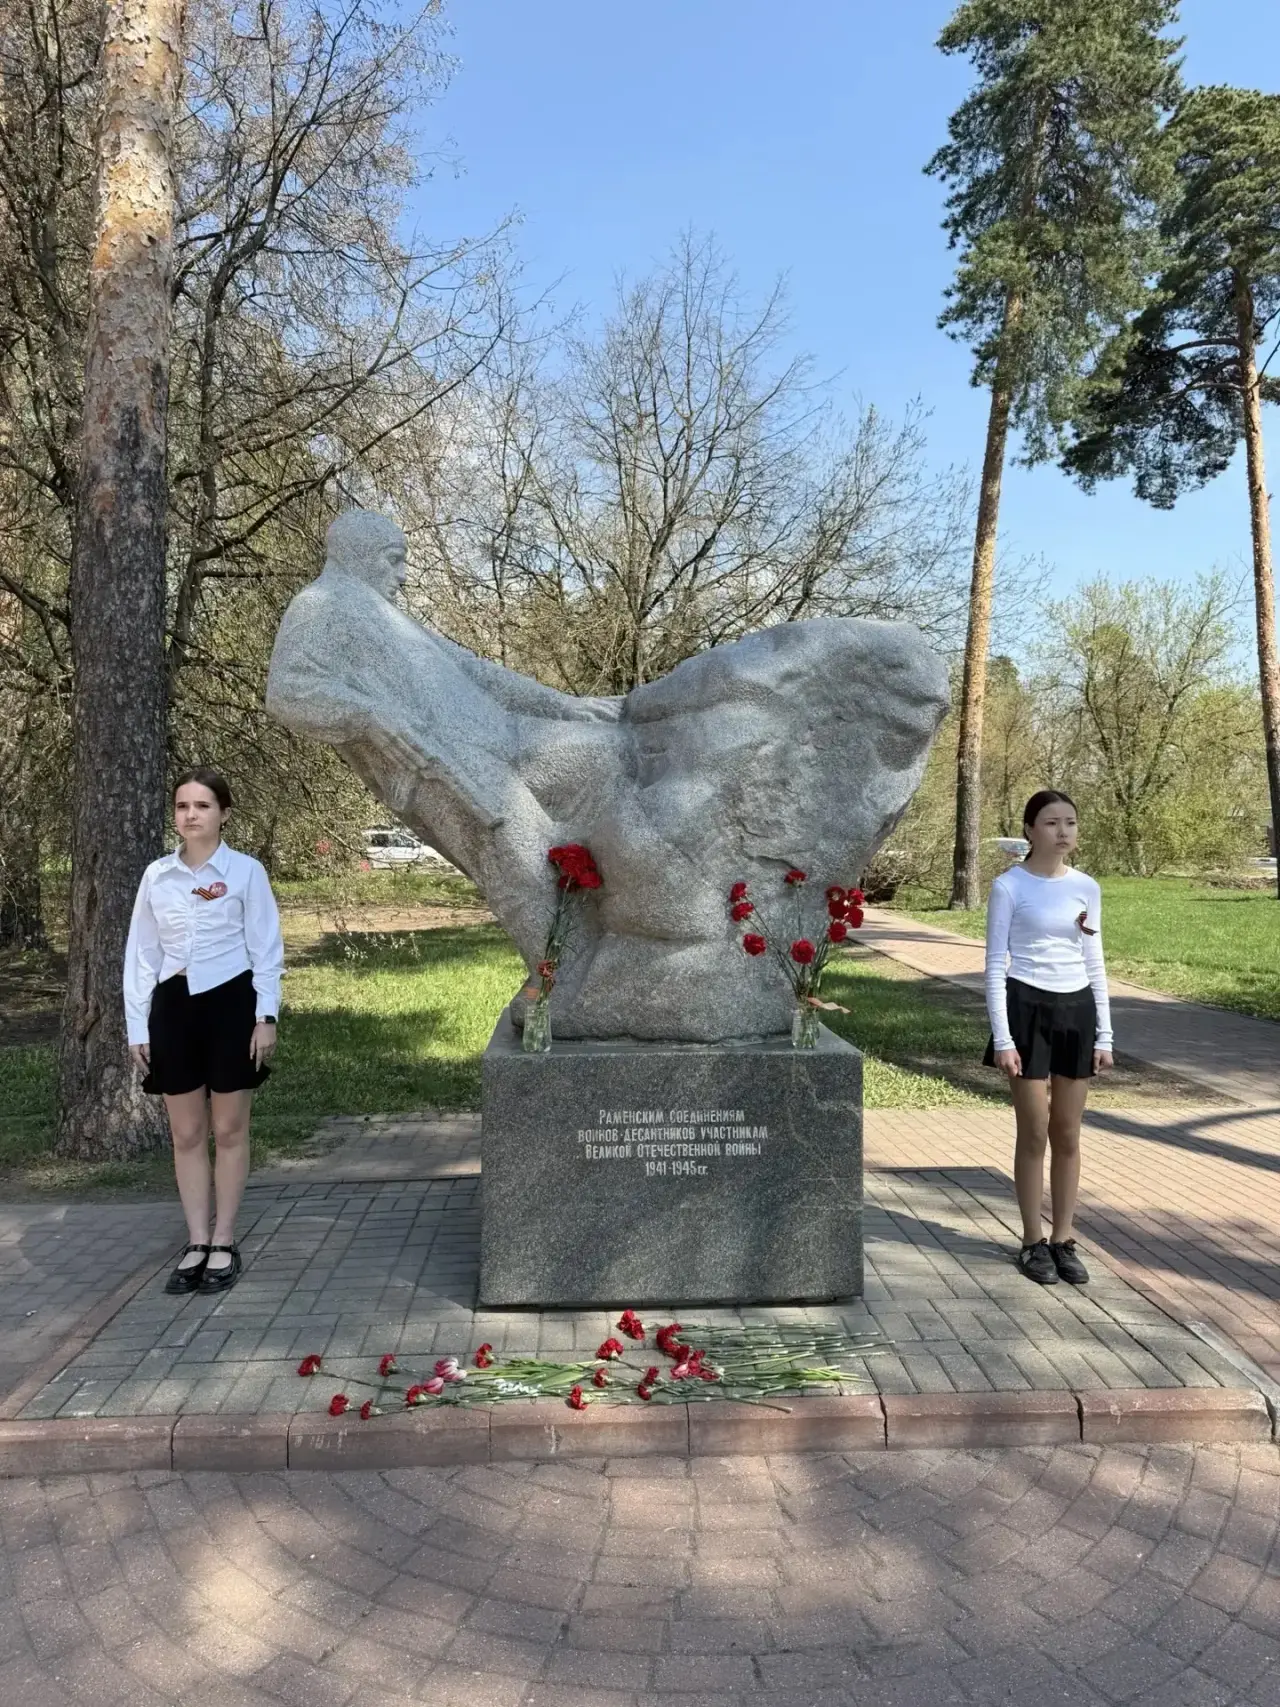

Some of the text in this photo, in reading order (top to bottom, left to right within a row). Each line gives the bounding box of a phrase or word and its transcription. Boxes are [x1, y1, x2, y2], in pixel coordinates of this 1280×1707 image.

[599, 1109, 665, 1124] РАМЕНСКИМ
[700, 1126, 768, 1140] УЧАСТНИКАМ
[585, 1141, 762, 1160] ВЕЛИКОЙ ОТЕЧЕСТВЕННОЙ ВОЙНЫ
